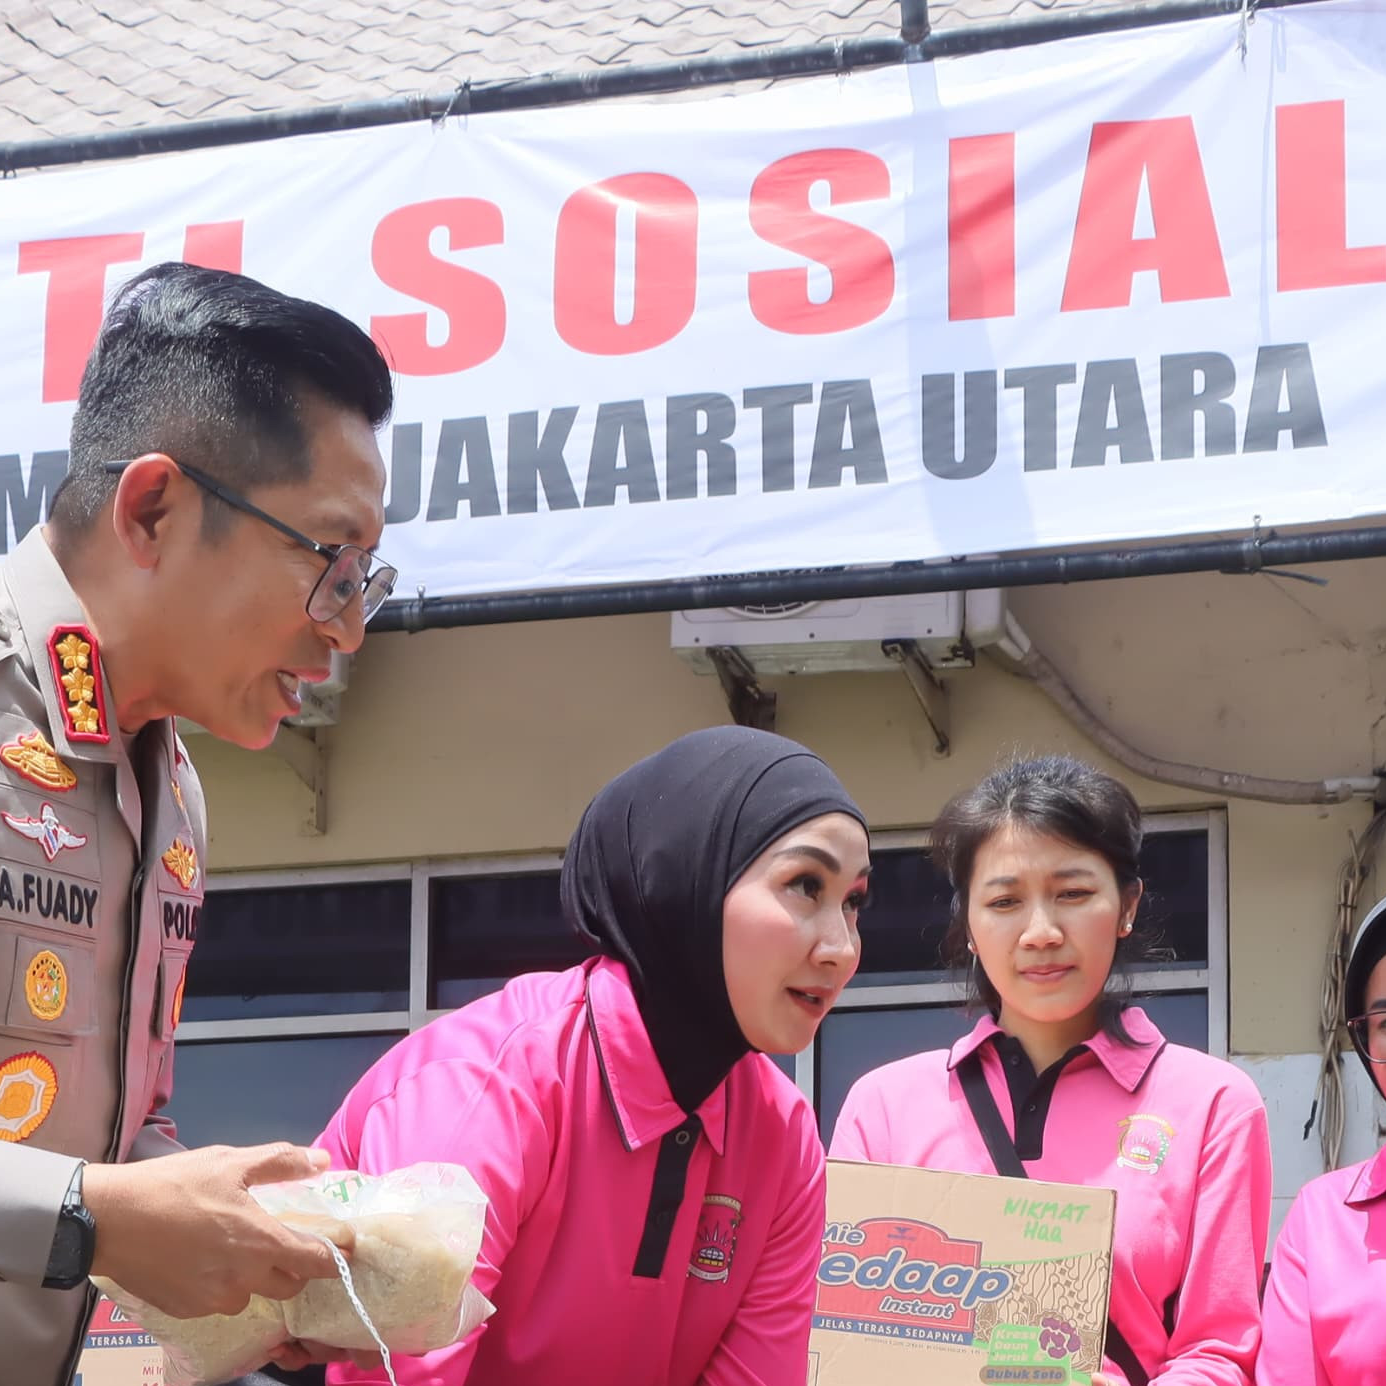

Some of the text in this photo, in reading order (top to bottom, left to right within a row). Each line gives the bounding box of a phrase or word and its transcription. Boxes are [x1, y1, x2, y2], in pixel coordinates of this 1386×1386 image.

[385, 378, 888, 524] JAKARTA
[920, 341, 1329, 481] UTARA
[1003, 1196, 1092, 1225] NIKMAT
[816, 1246, 1013, 1309] edaap
[880, 1295, 957, 1320] Instant
[91, 1335, 133, 1347] TERASA
[819, 1318, 965, 1344] JELAS TERASA SEDAPNYA
[986, 1368, 1030, 1380] Bubuk
